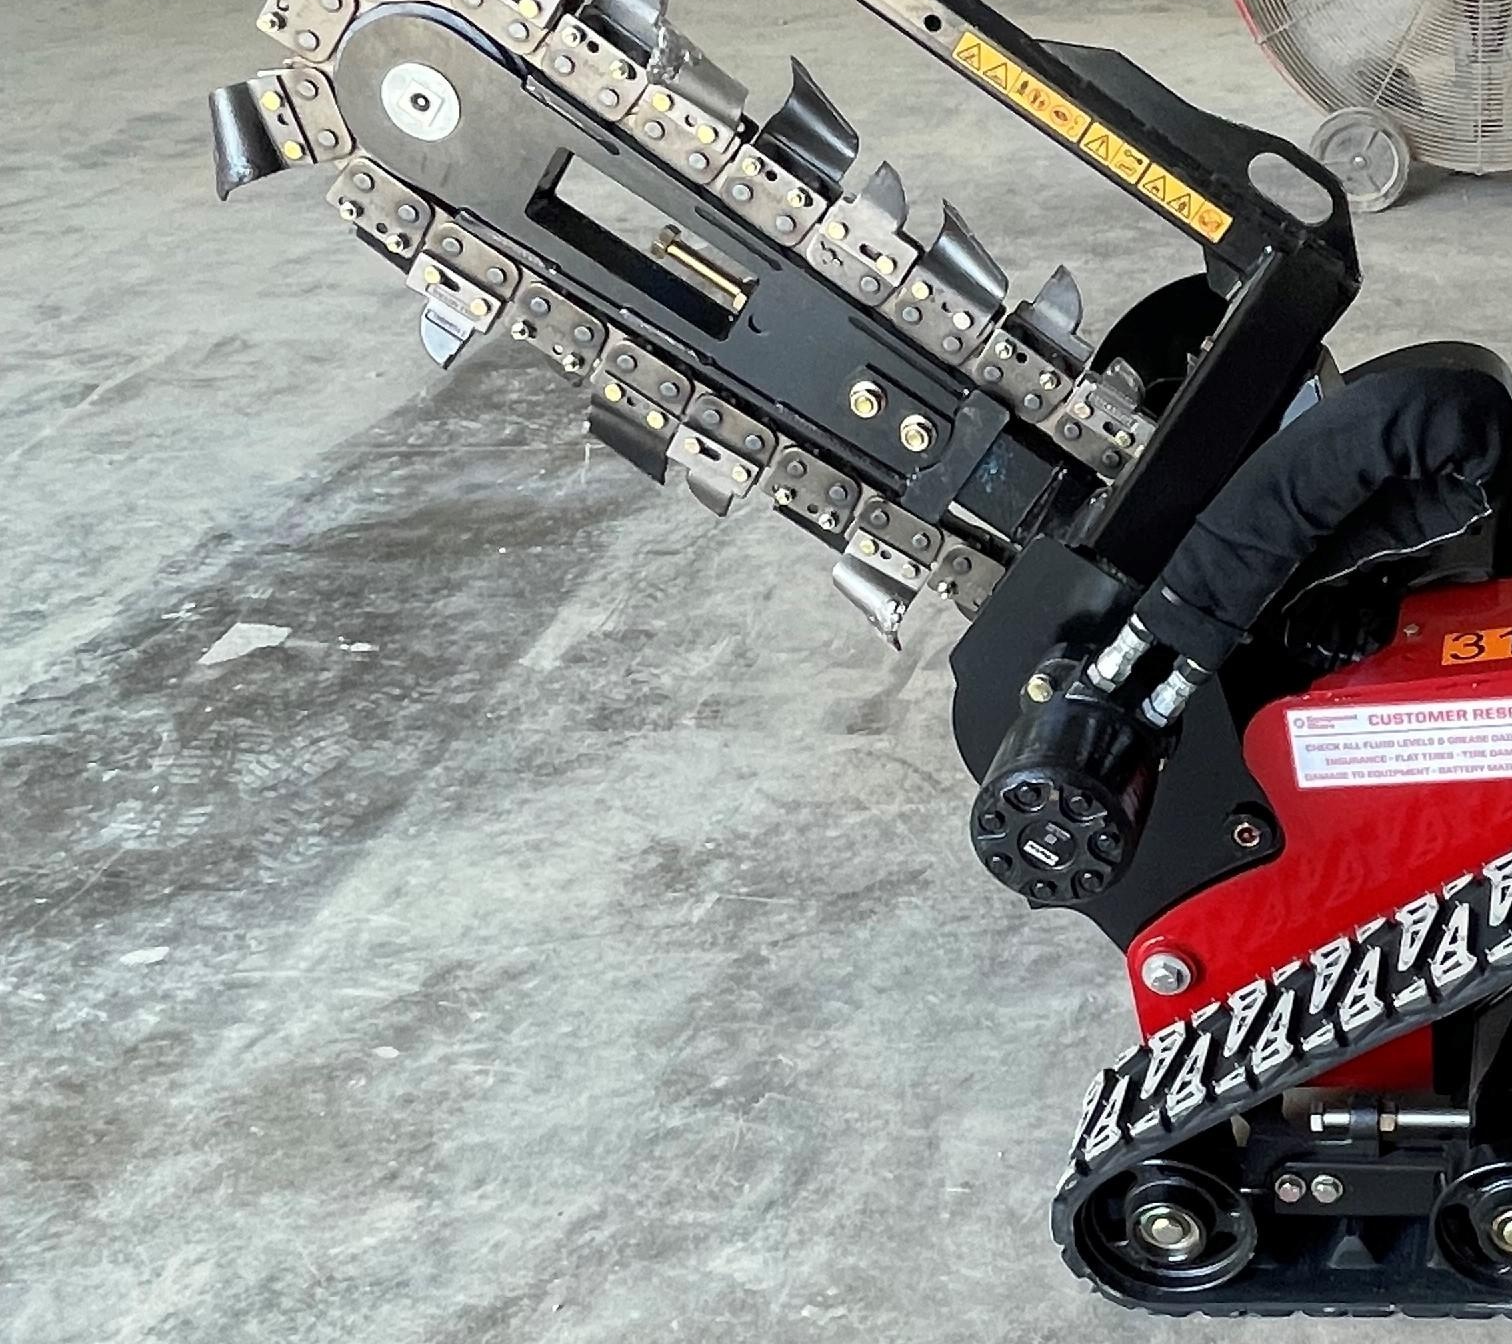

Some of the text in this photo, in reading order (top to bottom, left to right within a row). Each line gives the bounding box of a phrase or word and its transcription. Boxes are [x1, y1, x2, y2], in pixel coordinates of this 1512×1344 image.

[1368, 709, 1468, 726] CUSTOMER
[1342, 741, 1361, 750] ALL
[1397, 737, 1434, 748] LEVELS
[1367, 767, 1430, 778] EQUIPMENT
